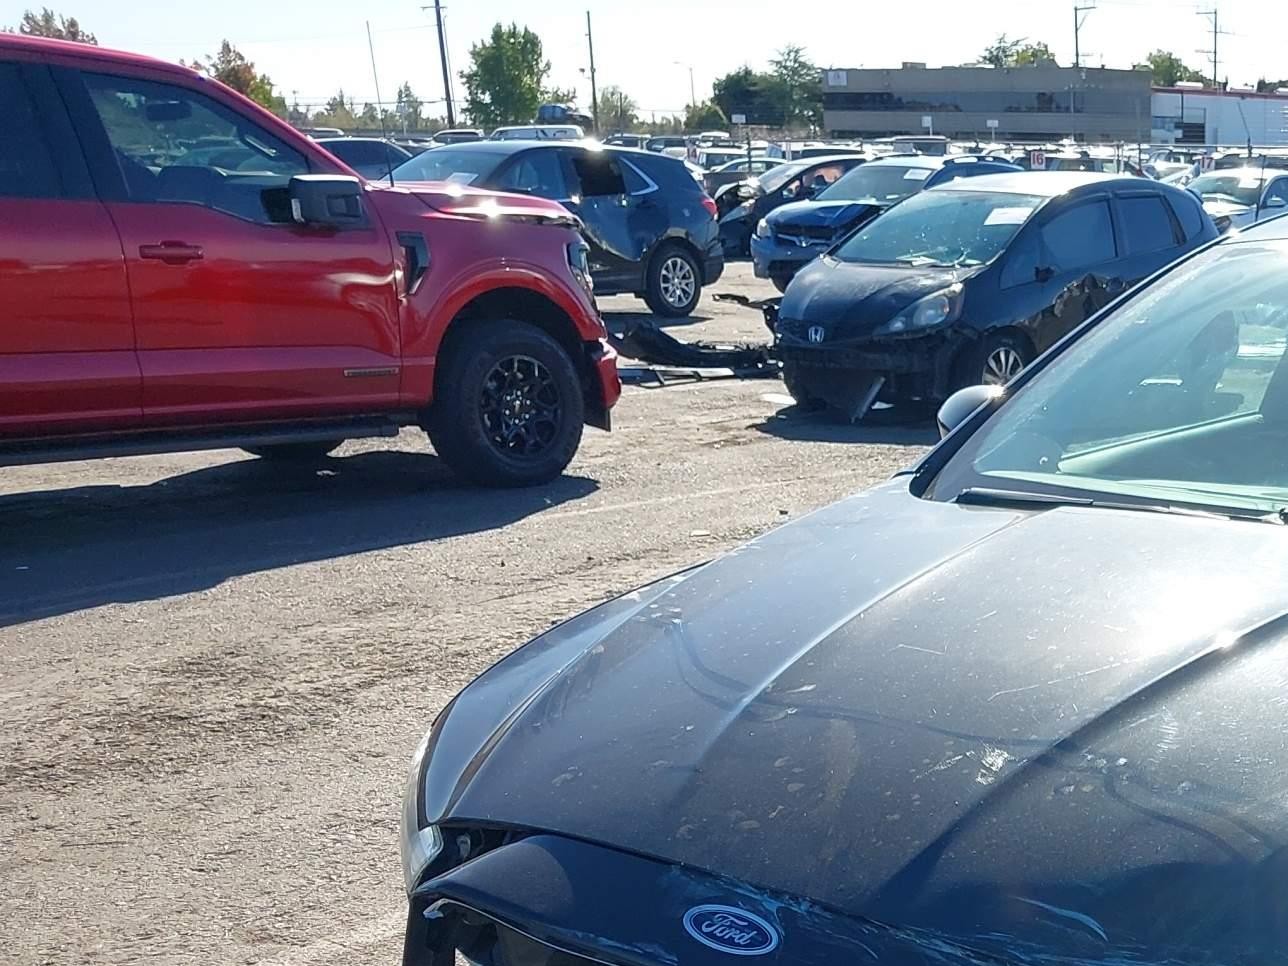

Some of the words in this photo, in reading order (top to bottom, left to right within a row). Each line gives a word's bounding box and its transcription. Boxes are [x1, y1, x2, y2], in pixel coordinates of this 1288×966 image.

[1032, 152, 1044, 166] 16
[1201, 157, 1214, 169] 17
[701, 912, 758, 945] Ford
